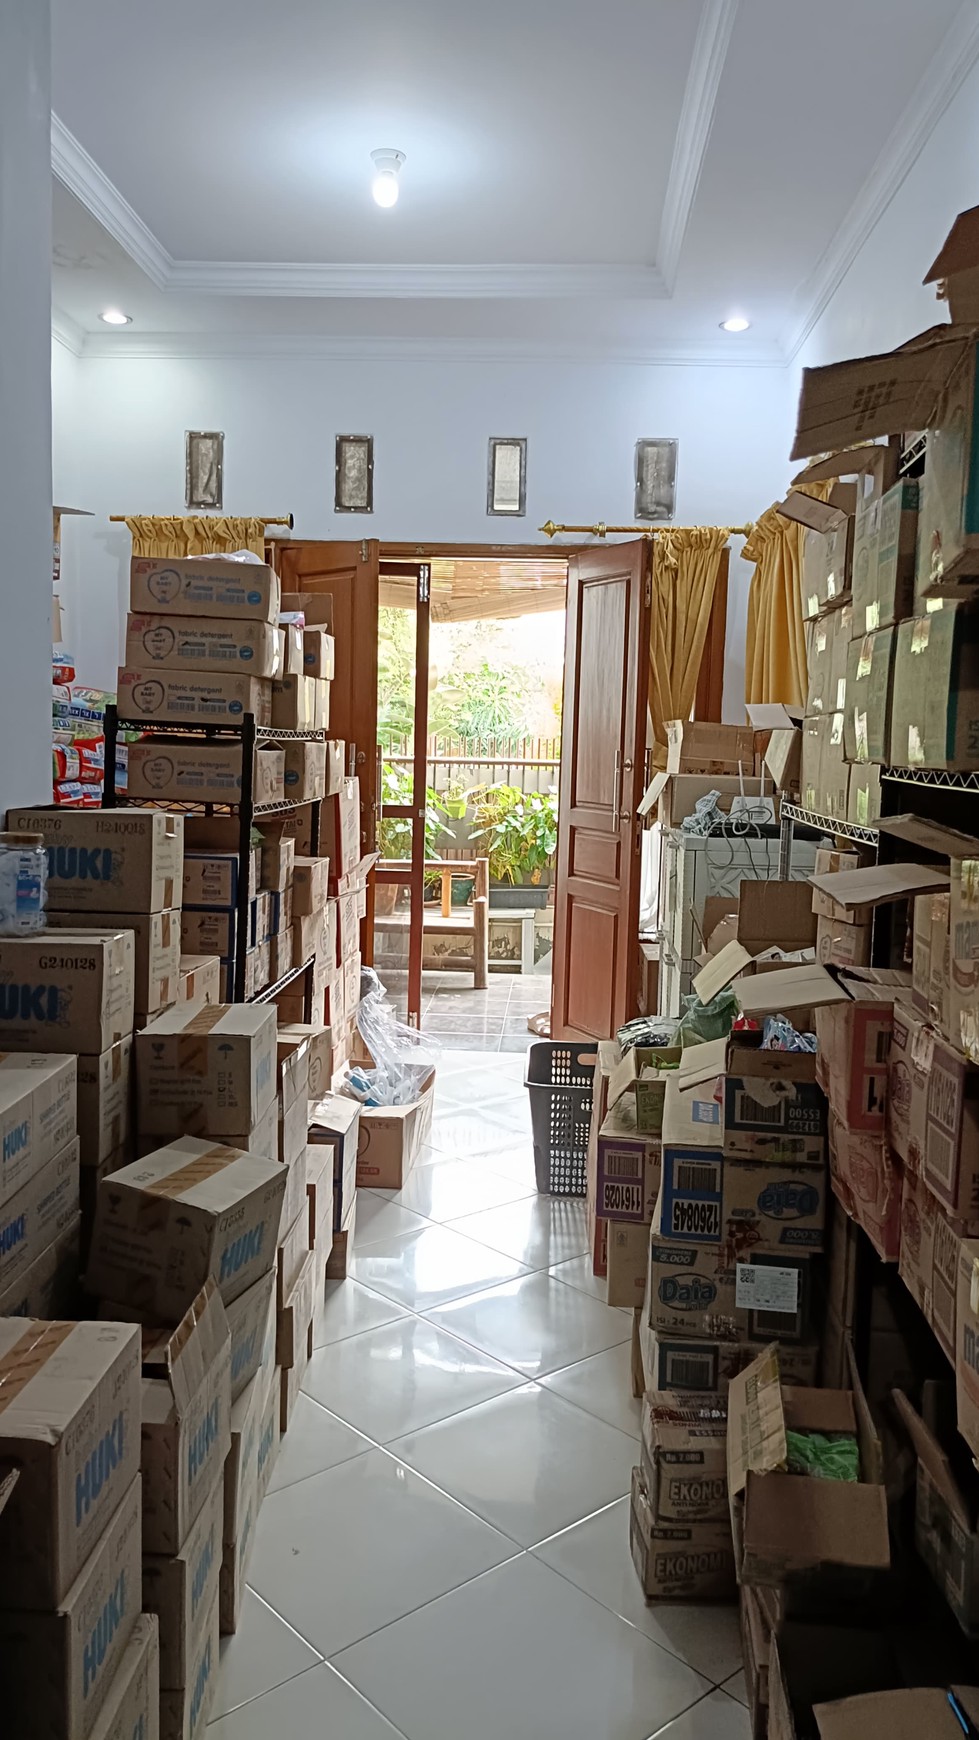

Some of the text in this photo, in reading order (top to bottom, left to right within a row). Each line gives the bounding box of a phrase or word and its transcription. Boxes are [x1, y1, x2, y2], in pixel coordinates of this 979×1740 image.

[178, 630, 233, 640] fabric detergent
[168, 684, 223, 695] fabric detergent
[197, 761, 230, 770] detergent
[0, 983, 59, 1022] UKI
[3, 1120, 28, 1163] HUKI
[604, 1184, 640, 1211] 1161026
[673, 1201, 719, 1234] 1260845
[219, 1220, 265, 1284] HUKI
[660, 1253, 691, 1264] 5.000
[661, 1277, 715, 1303] Daia
[75, 1409, 124, 1528] HUKI
[670, 1479, 728, 1501] EKONO
[83, 1567, 127, 1700] HUKI
